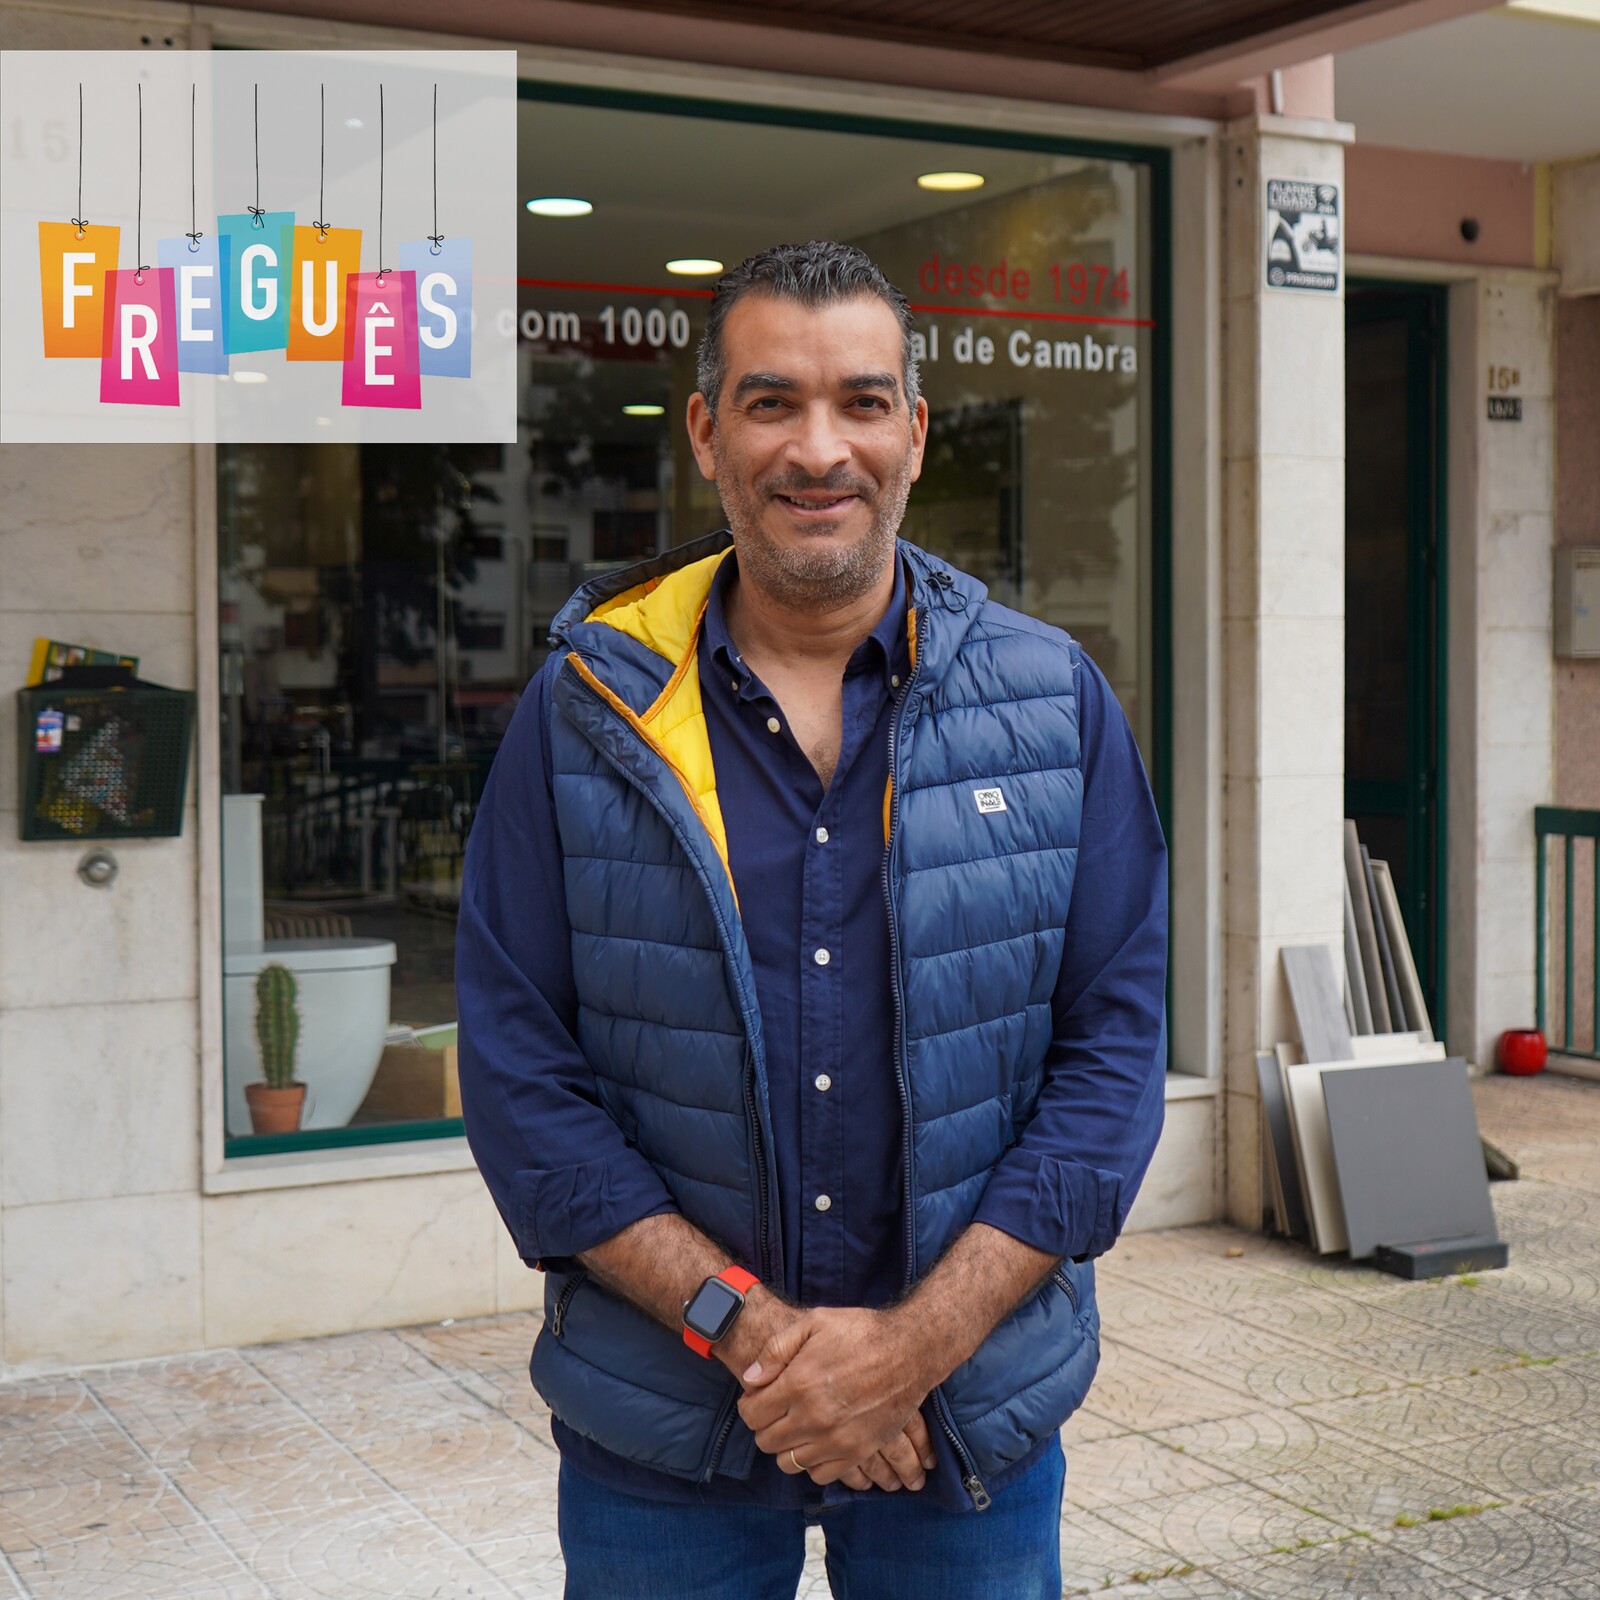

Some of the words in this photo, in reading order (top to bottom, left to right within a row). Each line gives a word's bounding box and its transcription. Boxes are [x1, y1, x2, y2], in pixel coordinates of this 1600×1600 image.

[918, 252, 1031, 301] desde
[1050, 262, 1131, 306] 1974
[599, 304, 691, 348] 1000
[909, 324, 939, 362] al
[953, 326, 995, 365] de
[1007, 328, 1138, 373] Cambra
